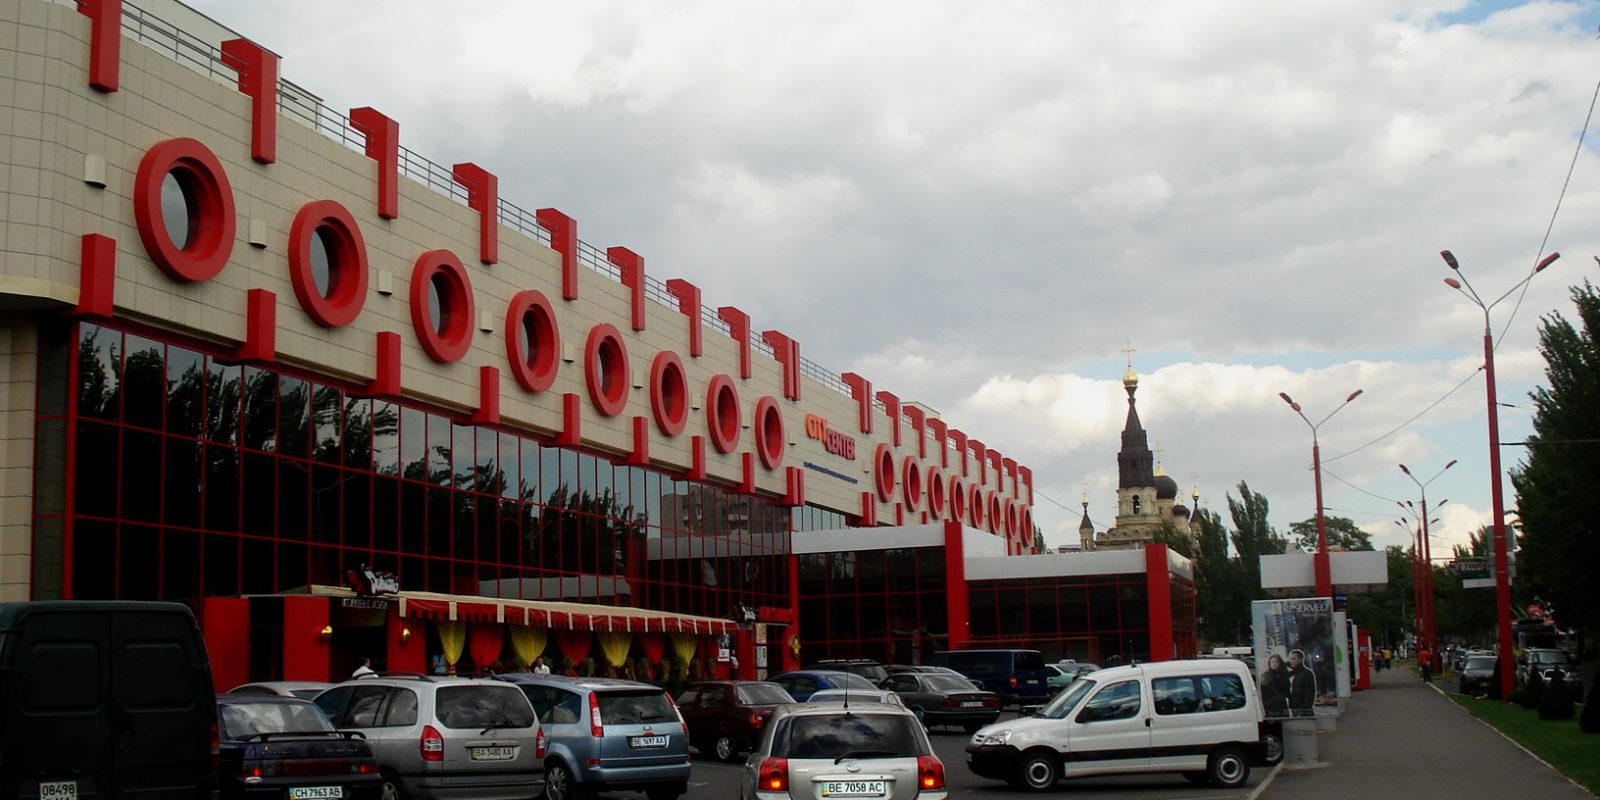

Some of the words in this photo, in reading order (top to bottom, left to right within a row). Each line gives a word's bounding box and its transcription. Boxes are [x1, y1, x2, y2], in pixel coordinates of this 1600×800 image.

[806, 412, 828, 443] CITY
[825, 428, 856, 461] CENTER
[1282, 603, 1328, 615] RESERVED
[42, 784, 75, 796] 08498
[295, 788, 308, 798] CH
[309, 787, 328, 797] 7963
[329, 786, 340, 796] AB
[828, 783, 842, 793] BE
[844, 782, 867, 793] 7058
[869, 782, 882, 792] AC
